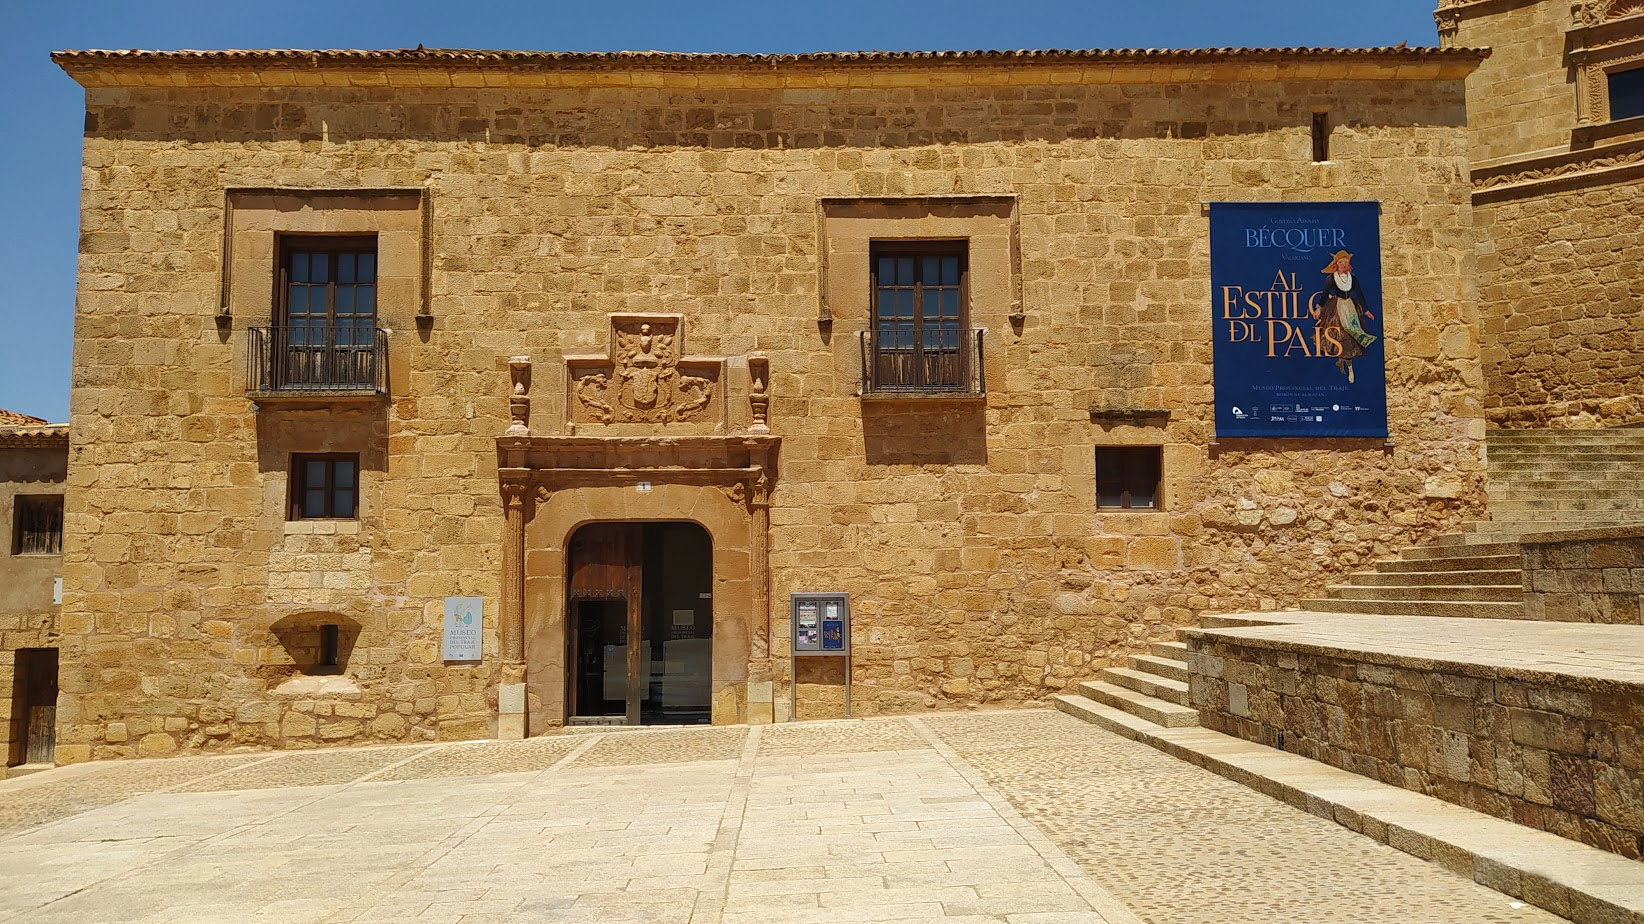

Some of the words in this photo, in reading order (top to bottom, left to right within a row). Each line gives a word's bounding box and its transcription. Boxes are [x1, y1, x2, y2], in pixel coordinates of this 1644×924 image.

[1245, 225, 1346, 252] BÉCQUER
[1270, 269, 1303, 291] AL
[1264, 319, 1344, 358] PAÍS
